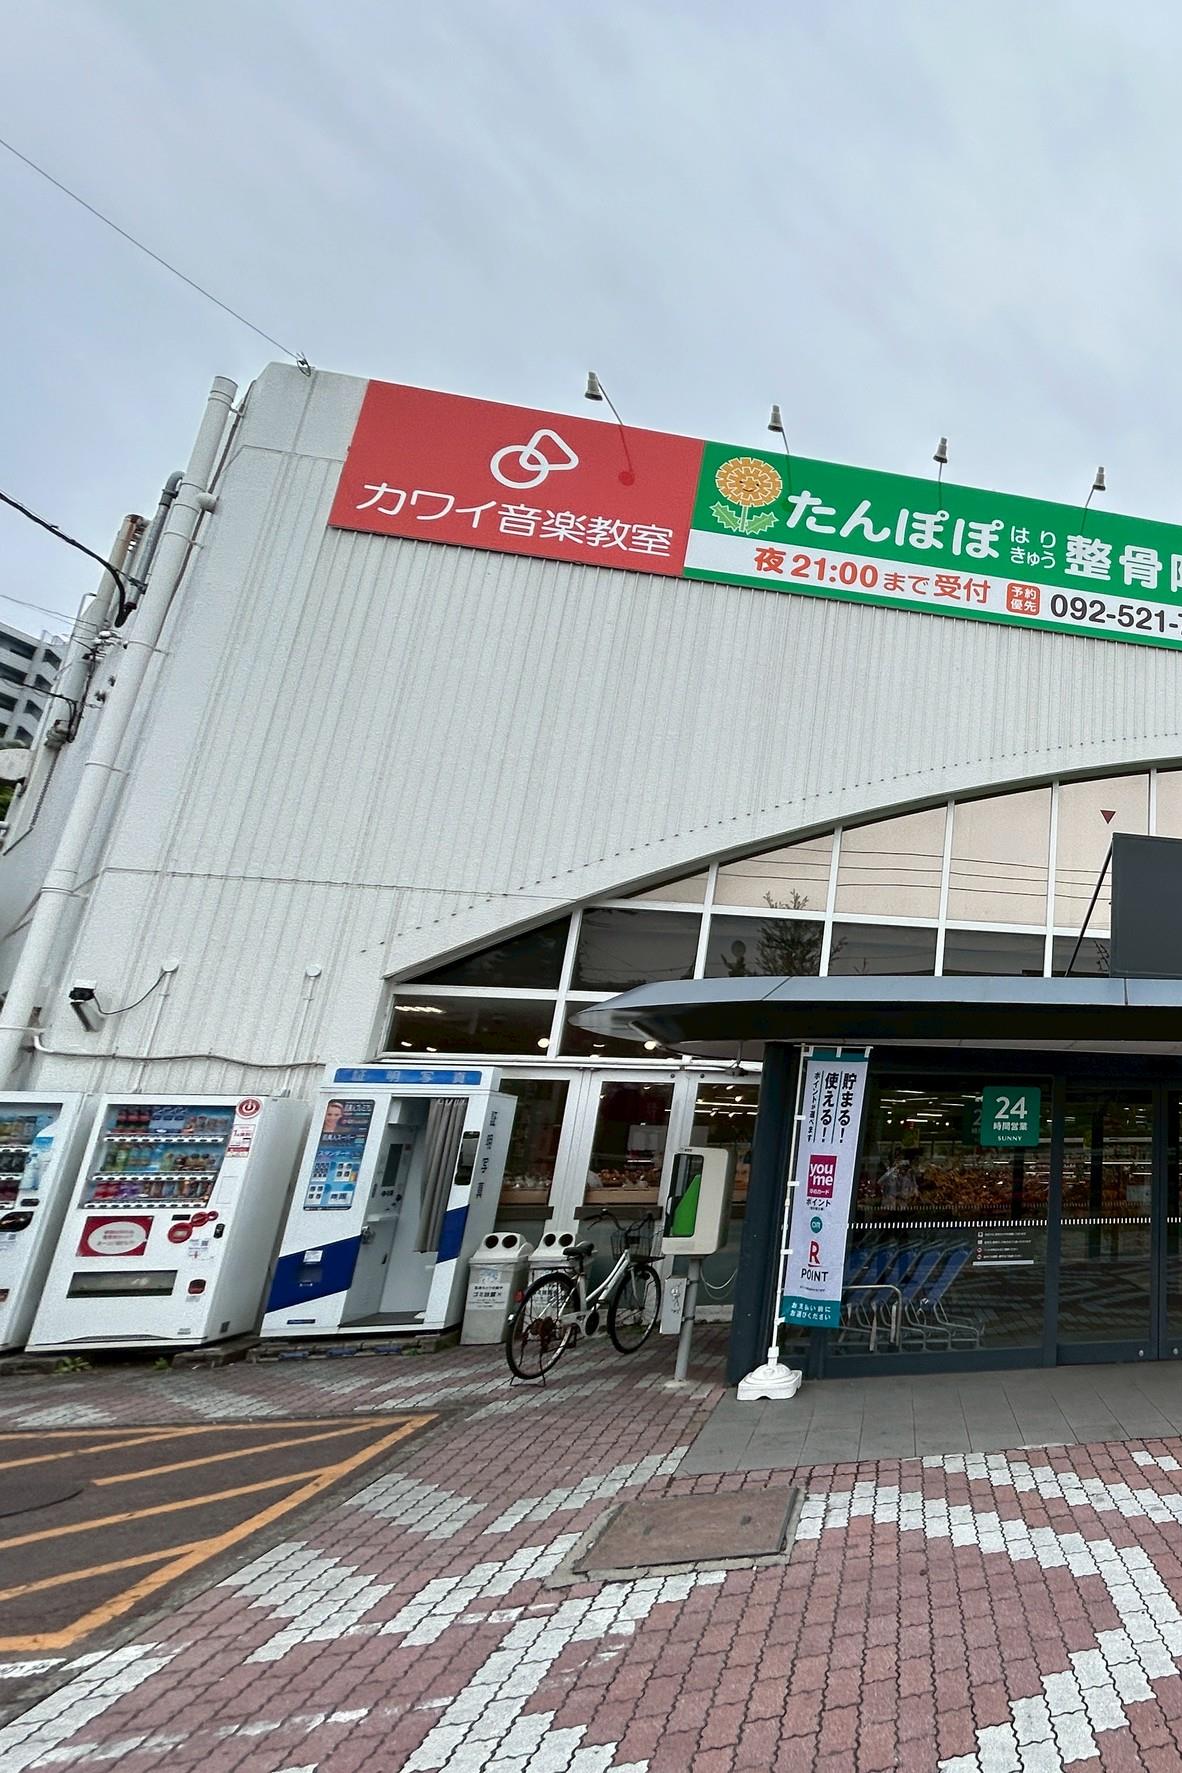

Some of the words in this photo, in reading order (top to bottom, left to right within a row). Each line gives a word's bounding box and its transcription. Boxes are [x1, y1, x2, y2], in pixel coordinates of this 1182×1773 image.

[356, 482, 673, 557] カワイ音楽教室
[786, 490, 1004, 559] たんぽぽ
[1010, 547, 1056, 569] きゅう
[1011, 585, 1037, 600] 予約
[1011, 598, 1037, 613] 優先
[820, 1072, 839, 1142] 使える！
[838, 1073, 857, 1143] 貯まる！
[994, 1096, 1028, 1119] 24
[993, 1121, 1028, 1131] 時間営業
[810, 1163, 834, 1177] you
[813, 1175, 833, 1186] me
[806, 1198, 831, 1207] ポイント
[808, 1241, 821, 1266] R
[801, 1268, 829, 1281] POINT
